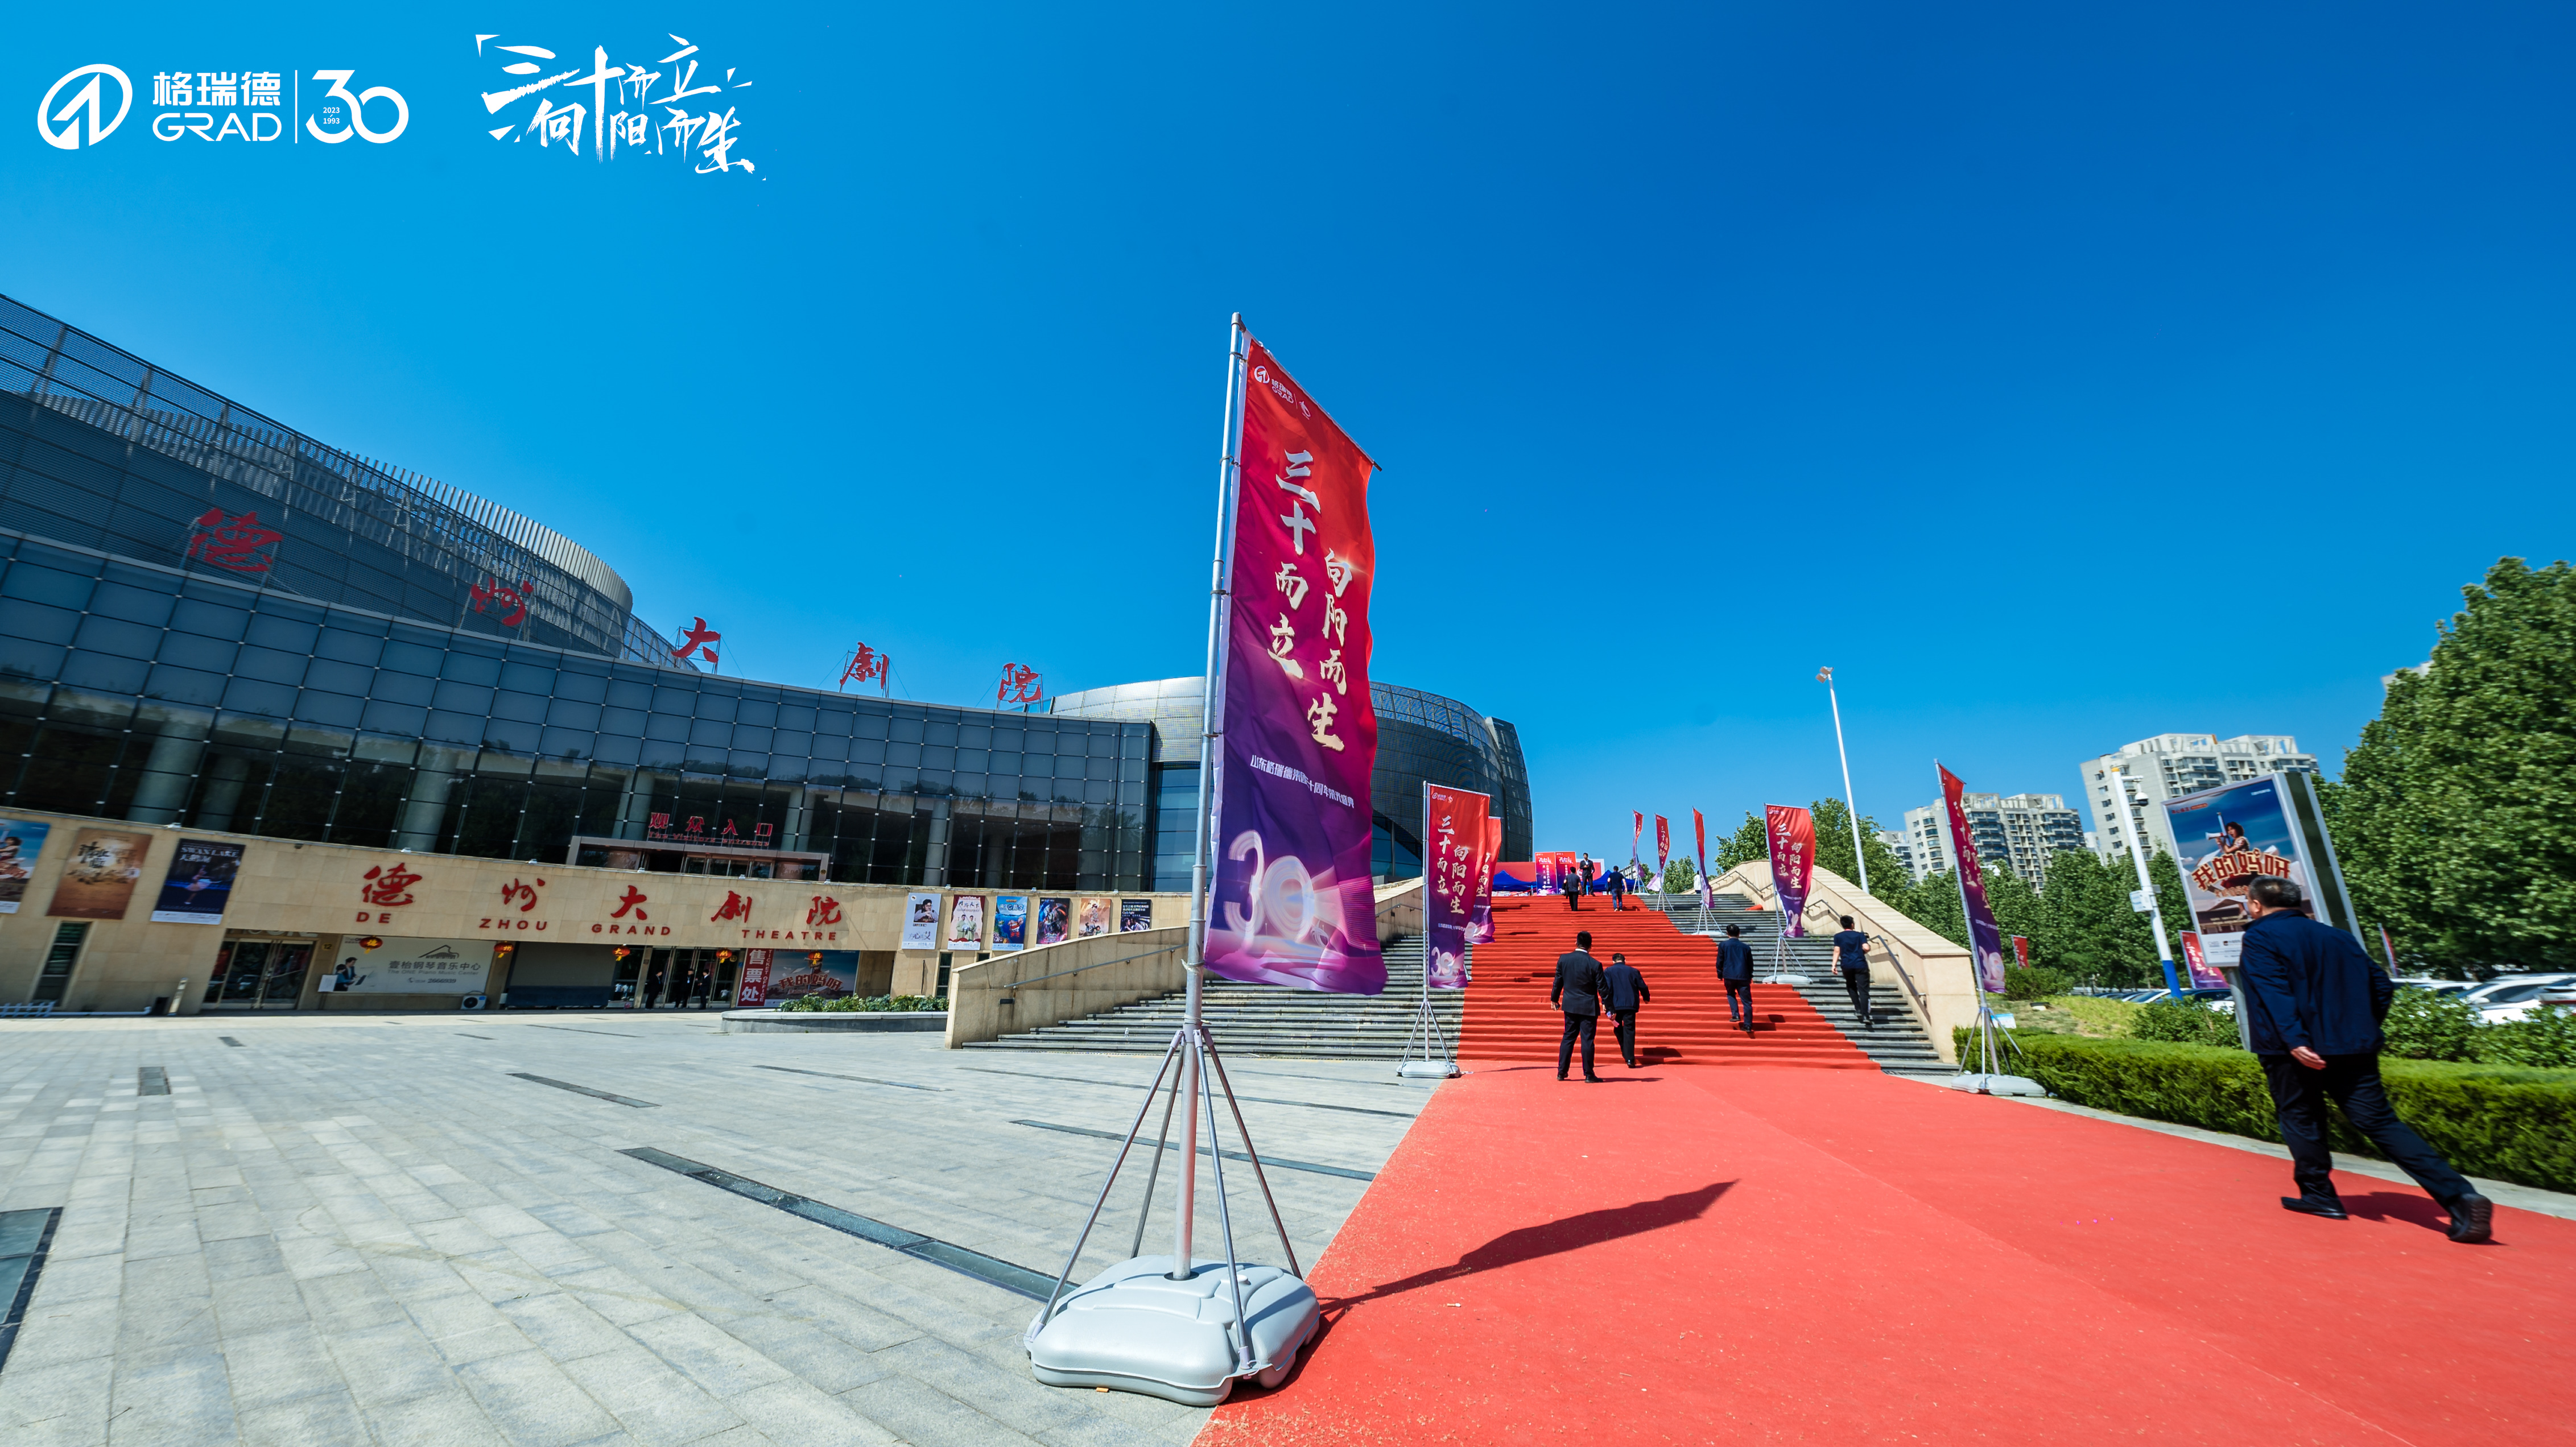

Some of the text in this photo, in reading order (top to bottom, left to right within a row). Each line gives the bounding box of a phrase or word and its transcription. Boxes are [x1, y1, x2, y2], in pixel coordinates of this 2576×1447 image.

[1272, 386, 1294, 404] GRAD
[1268, 449, 1321, 679] 三十而立
[1308, 547, 1353, 752] 向阳而生
[649, 812, 773, 837] 观众入口
[674, 833, 716, 842] Visitors
[1776, 823, 1791, 877] 三十而立
[1437, 815, 1455, 894] 三十而立
[1450, 845, 1469, 914] 向阳而生
[1789, 842, 1802, 888] 向阳而生
[362, 862, 841, 926] 德州大剧院
[1223, 829, 1315, 943] 30
[356, 912, 837, 940] DE ZHOU GRAND THEATRE
[741, 949, 766, 1001] 售票处
